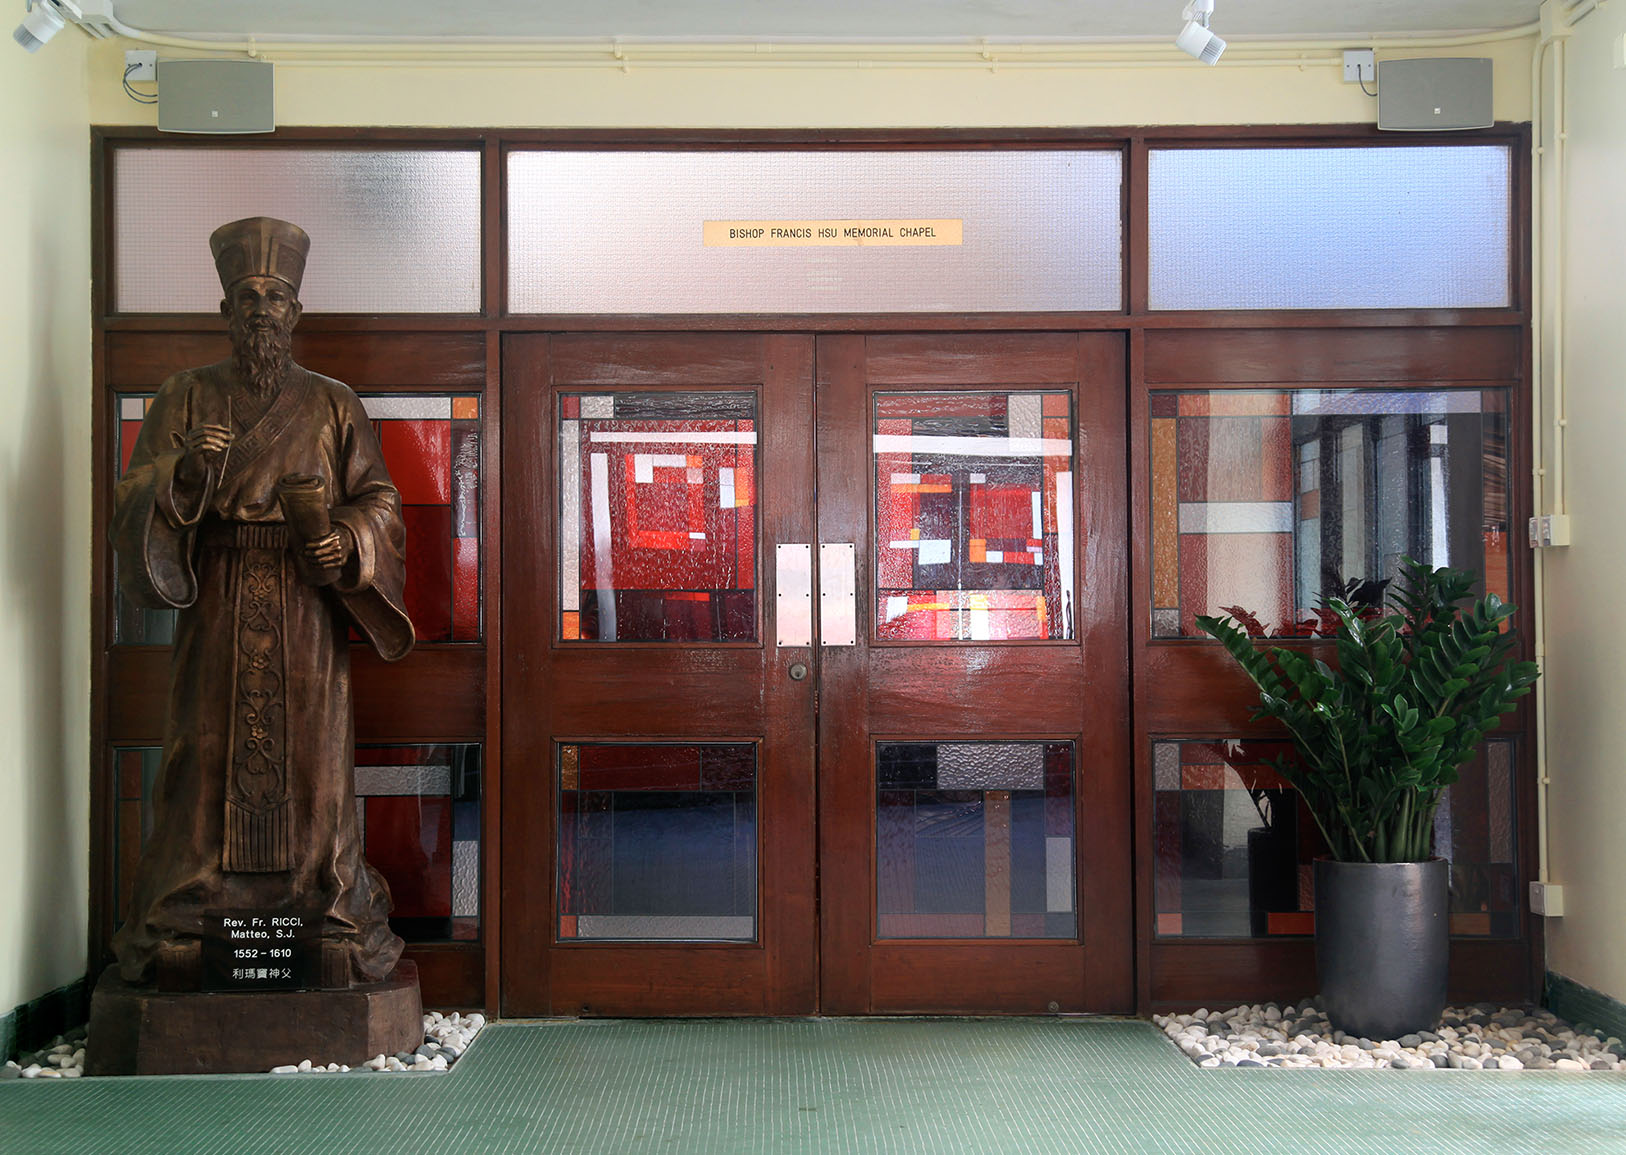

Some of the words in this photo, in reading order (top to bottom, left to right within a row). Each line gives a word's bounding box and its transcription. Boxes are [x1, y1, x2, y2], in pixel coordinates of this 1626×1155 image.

[729, 228, 765, 239] BISHOP
[770, 227, 812, 239] FRANCIS
[818, 227, 838, 238] HSU
[843, 227, 894, 238] MEMORIAL
[899, 226, 937, 238] CHAPEL
[223, 917, 247, 927] Rev.
[252, 917, 266, 927] Fr.
[271, 917, 303, 927] RICCI,
[231, 929, 271, 939] Matteo,
[275, 929, 295, 938] S.J.
[233, 949, 258, 958] 1552
[269, 948, 292, 958] 1610
